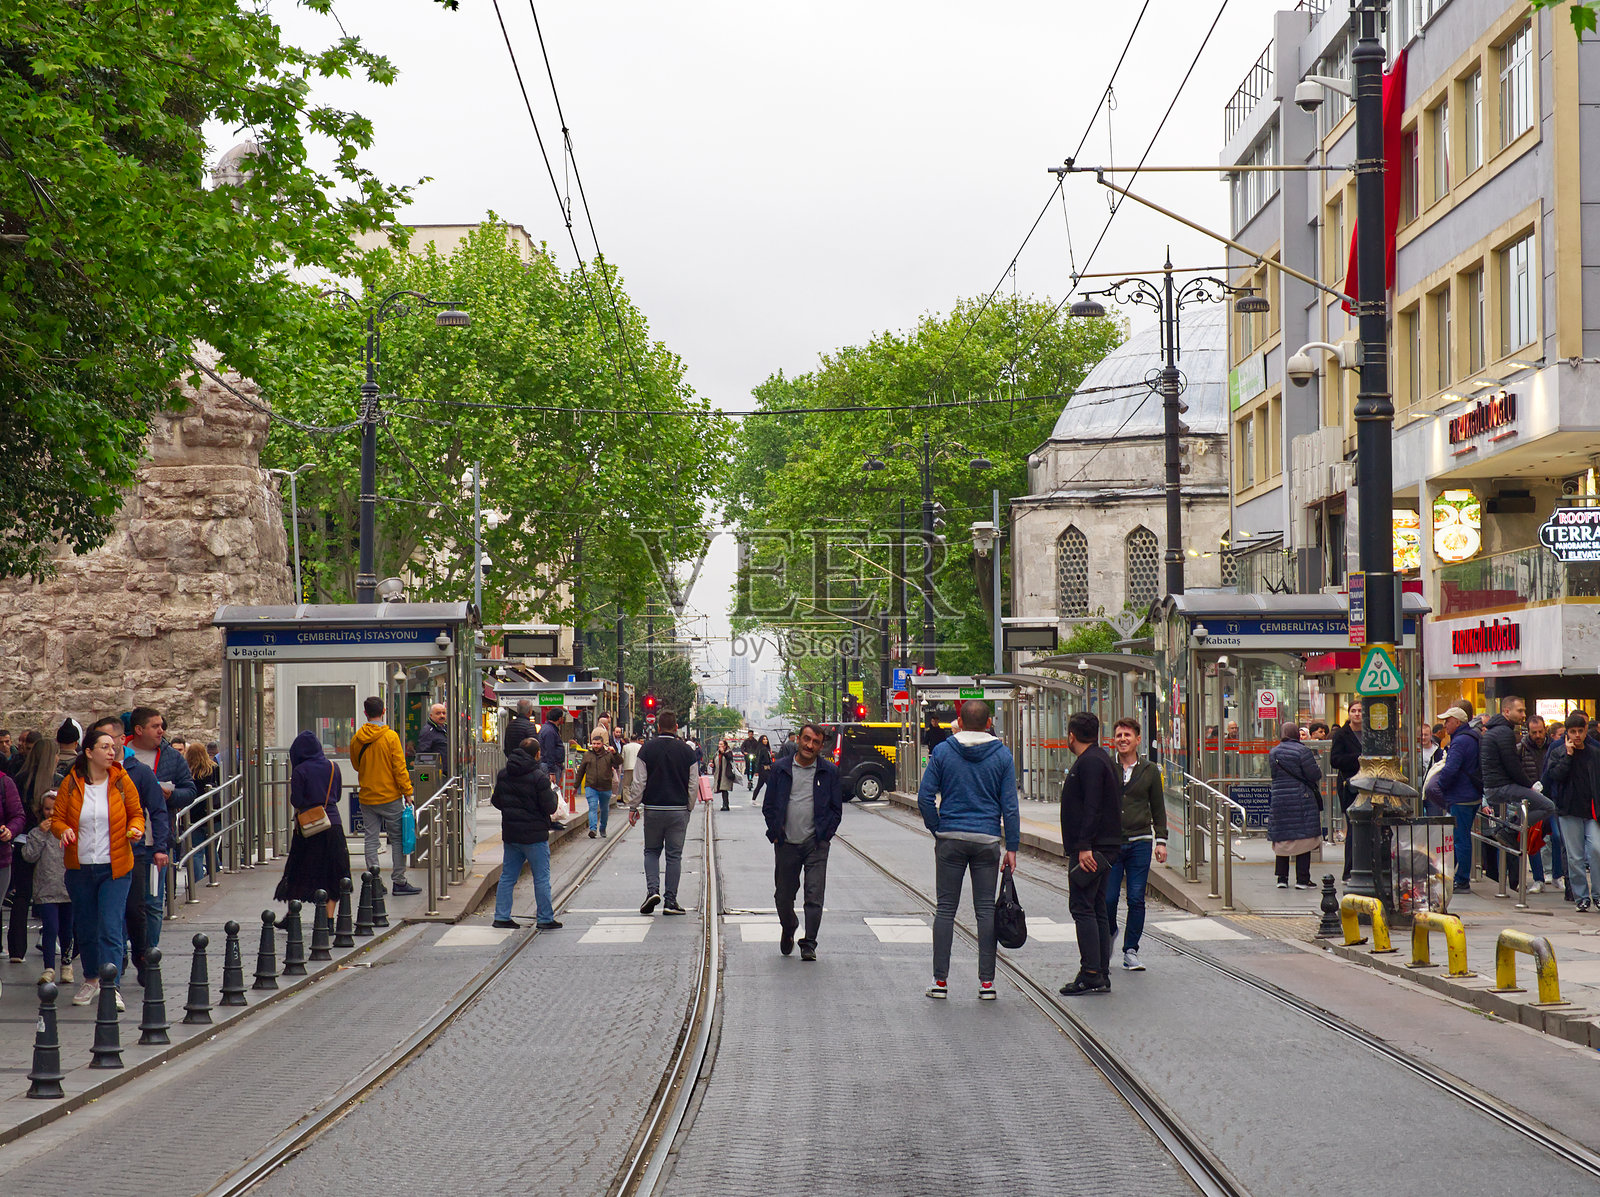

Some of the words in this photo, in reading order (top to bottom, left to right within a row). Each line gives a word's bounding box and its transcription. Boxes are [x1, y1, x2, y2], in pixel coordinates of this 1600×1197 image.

[1228, 623, 1239, 632] T1
[1260, 621, 1324, 633] ÇEMBERLİTAŞ
[265, 634, 275, 643] T1
[297, 631, 361, 643] ÇEMBERLİTAŞ
[364, 631, 418, 640] İSTASYONU
[1206, 637, 1241, 646] Kabataş
[242, 648, 277, 657] Bağcılar
[1368, 669, 1391, 688] 20
